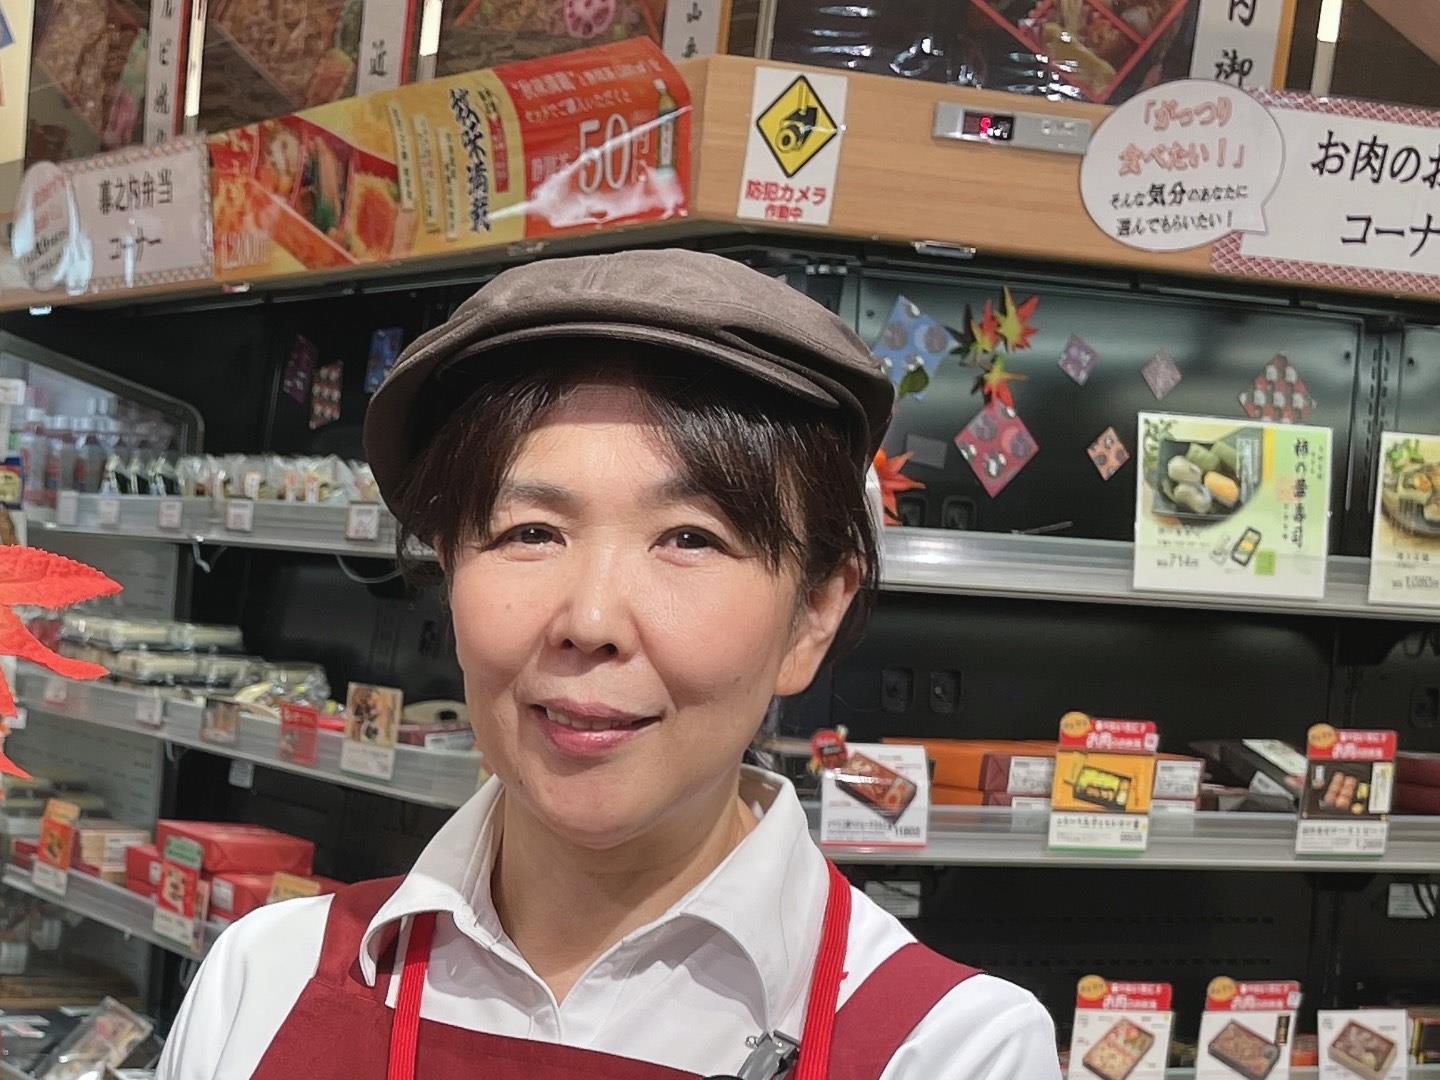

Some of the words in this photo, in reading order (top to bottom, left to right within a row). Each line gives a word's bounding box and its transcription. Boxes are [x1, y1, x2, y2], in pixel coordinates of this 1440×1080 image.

[745, 180, 827, 207] 防犯カメラ
